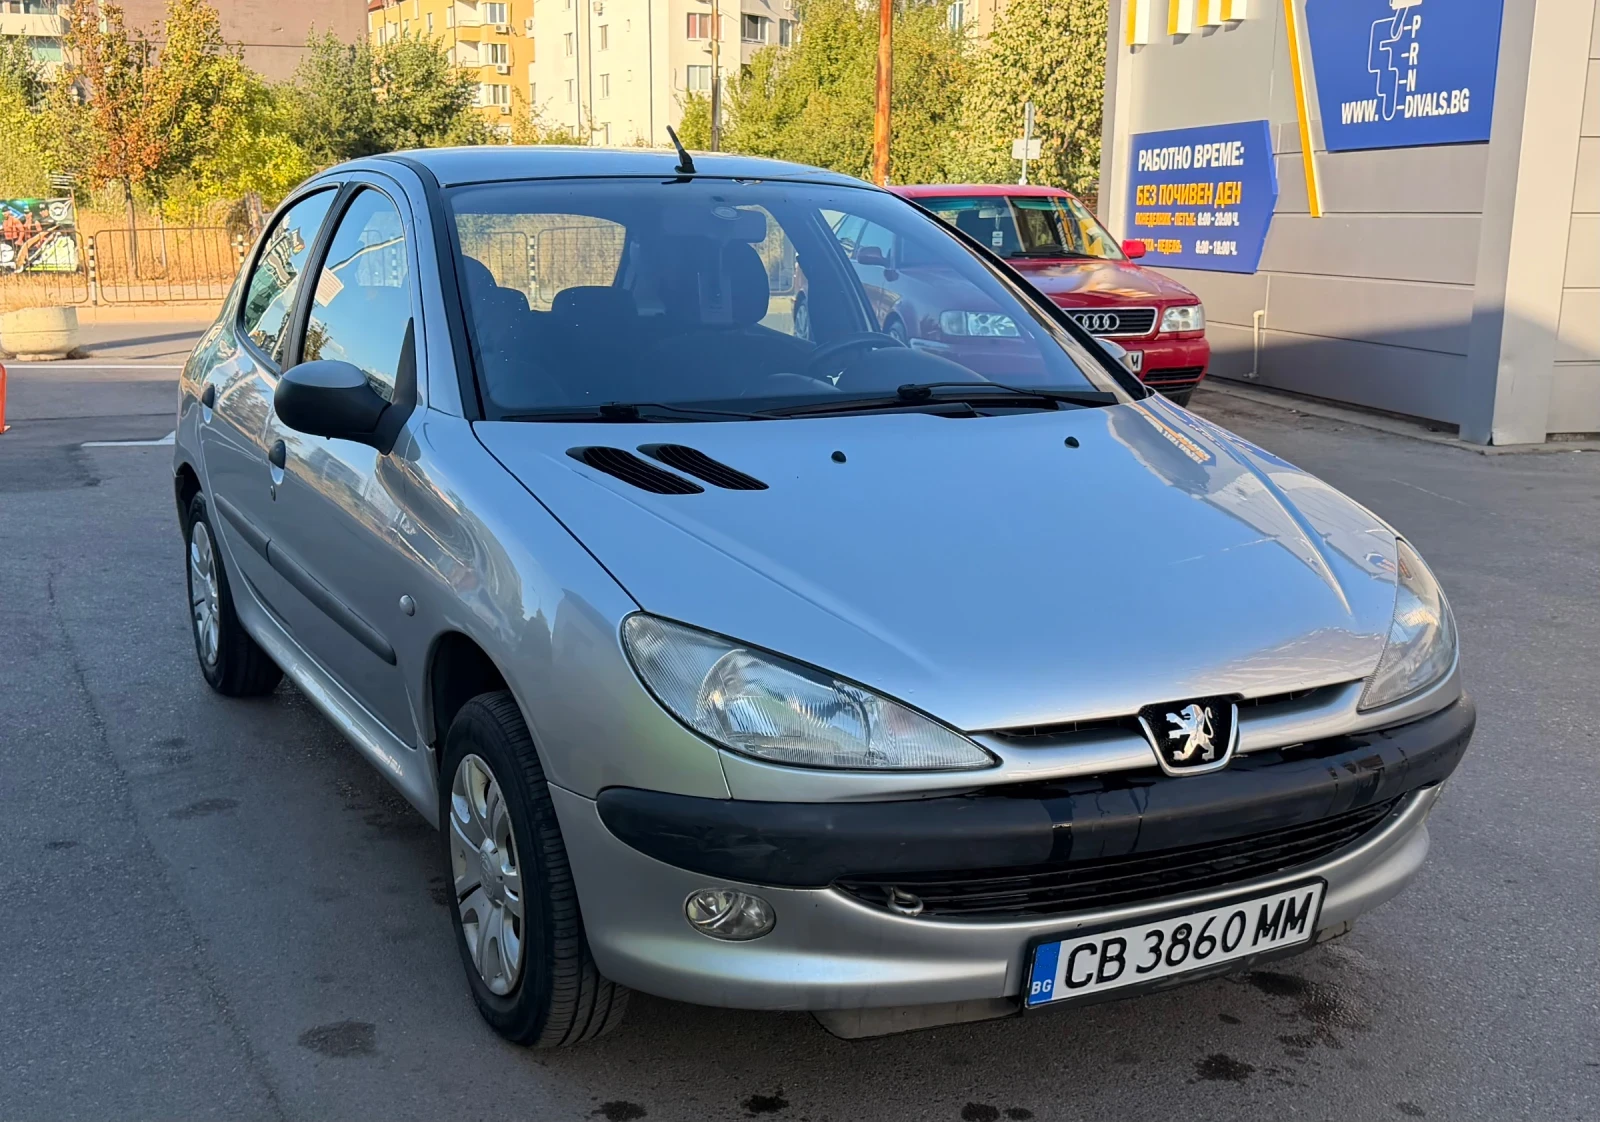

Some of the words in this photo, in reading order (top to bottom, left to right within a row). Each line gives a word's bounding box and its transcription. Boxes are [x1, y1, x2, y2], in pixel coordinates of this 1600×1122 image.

[1411, 15, 1421, 38] P
[1408, 42, 1419, 65] R
[1406, 69, 1416, 92] N
[1341, 99, 1379, 125] WWW.
[1138, 146, 1192, 172] РАБОТНО
[1193, 141, 1244, 169] ВРЕМЕ:
[1136, 185, 1157, 206] БЕЗ
[1158, 183, 1214, 206] ПОЧИВЕН
[1213, 181, 1242, 209] ДЕН
[1065, 936, 1127, 989] CB
[1135, 909, 1247, 974] 3860
[1251, 891, 1314, 947] MM
[1031, 979, 1052, 995] BG
